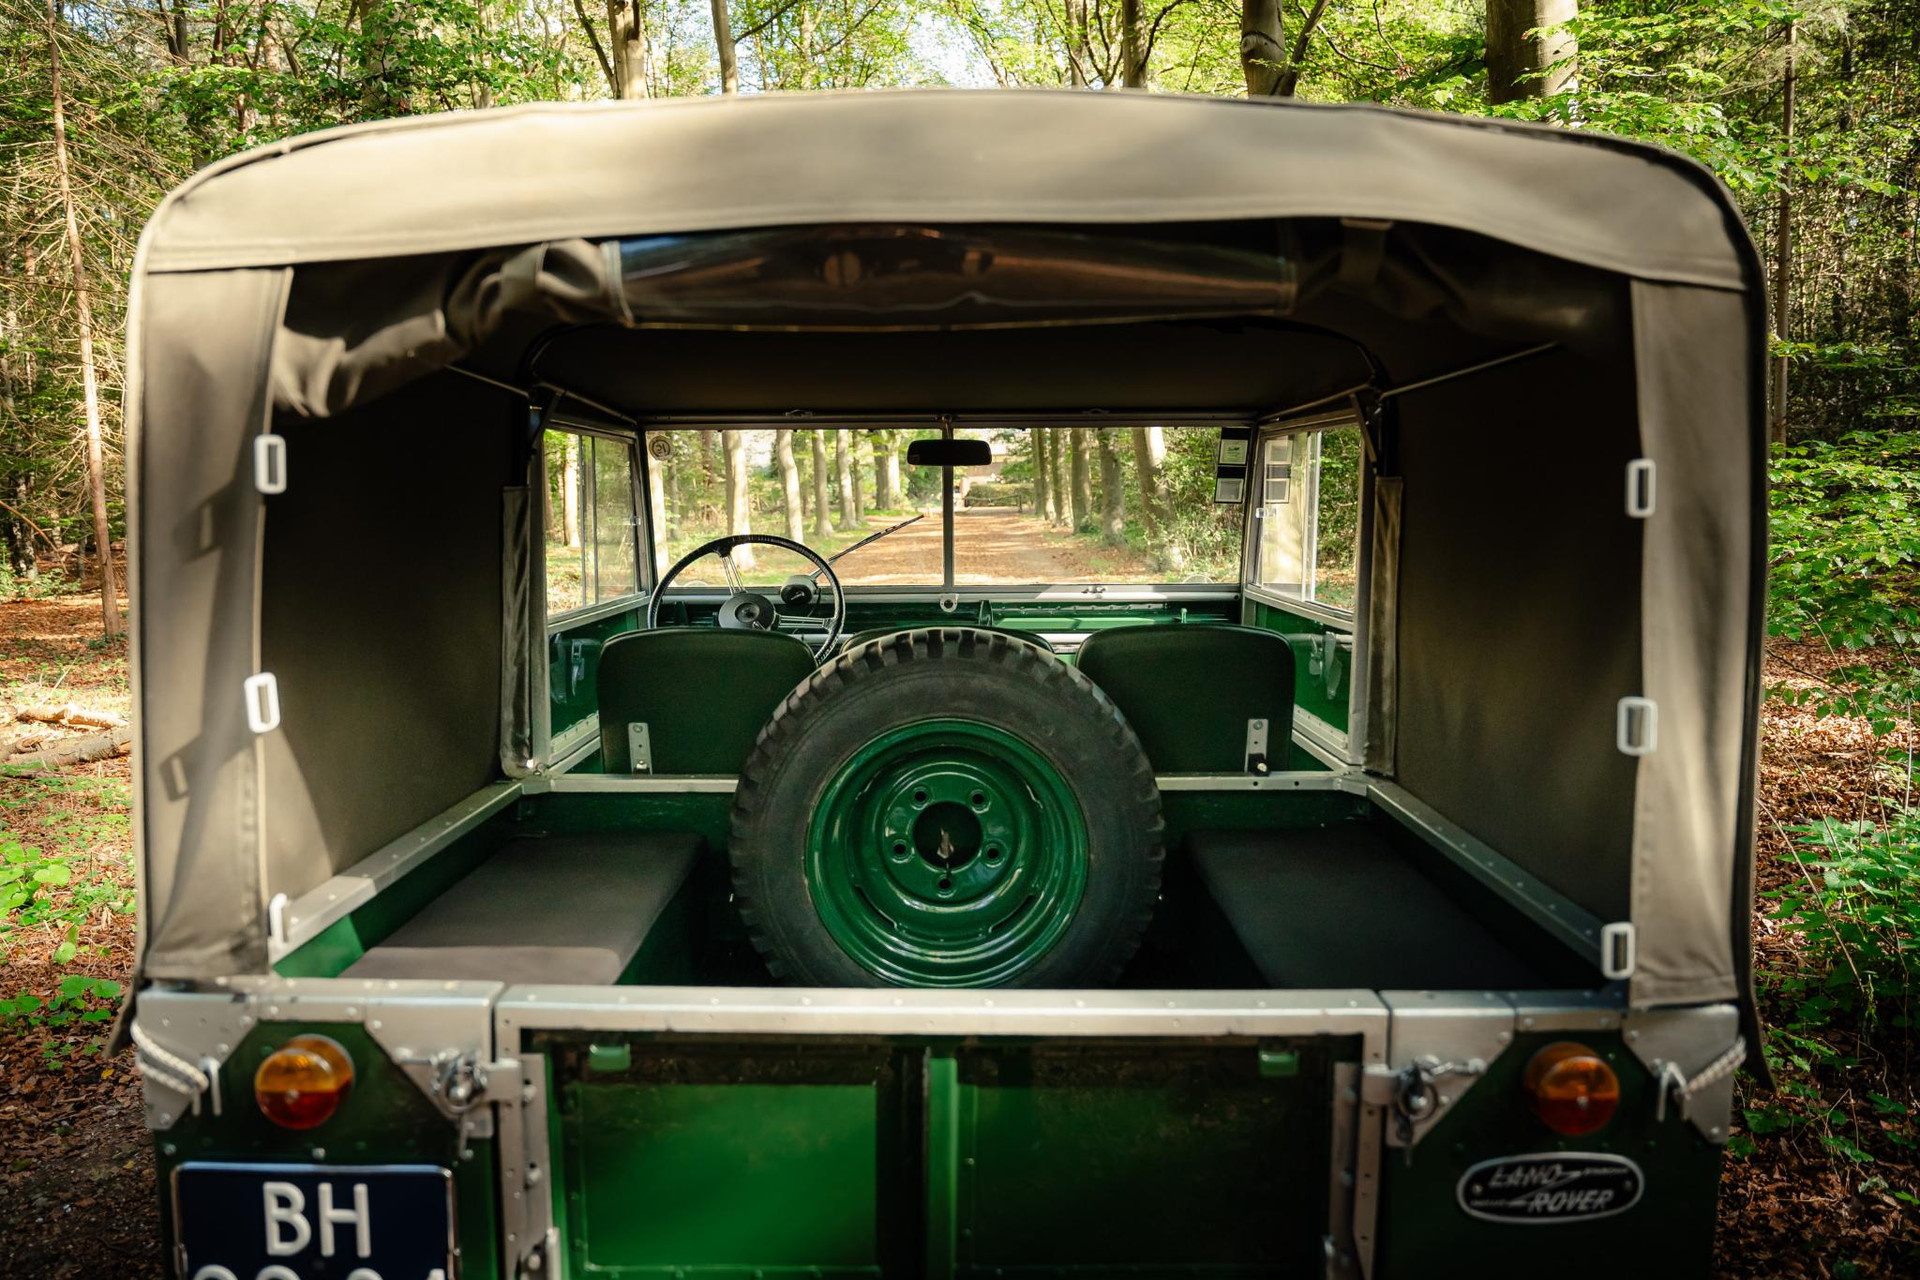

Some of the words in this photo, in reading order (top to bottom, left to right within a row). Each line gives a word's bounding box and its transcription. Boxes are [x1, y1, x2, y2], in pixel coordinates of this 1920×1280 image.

[1489, 1164, 1563, 1187] LAND
[1527, 1189, 1614, 1213] ROVER
[262, 1181, 371, 1258] BH
